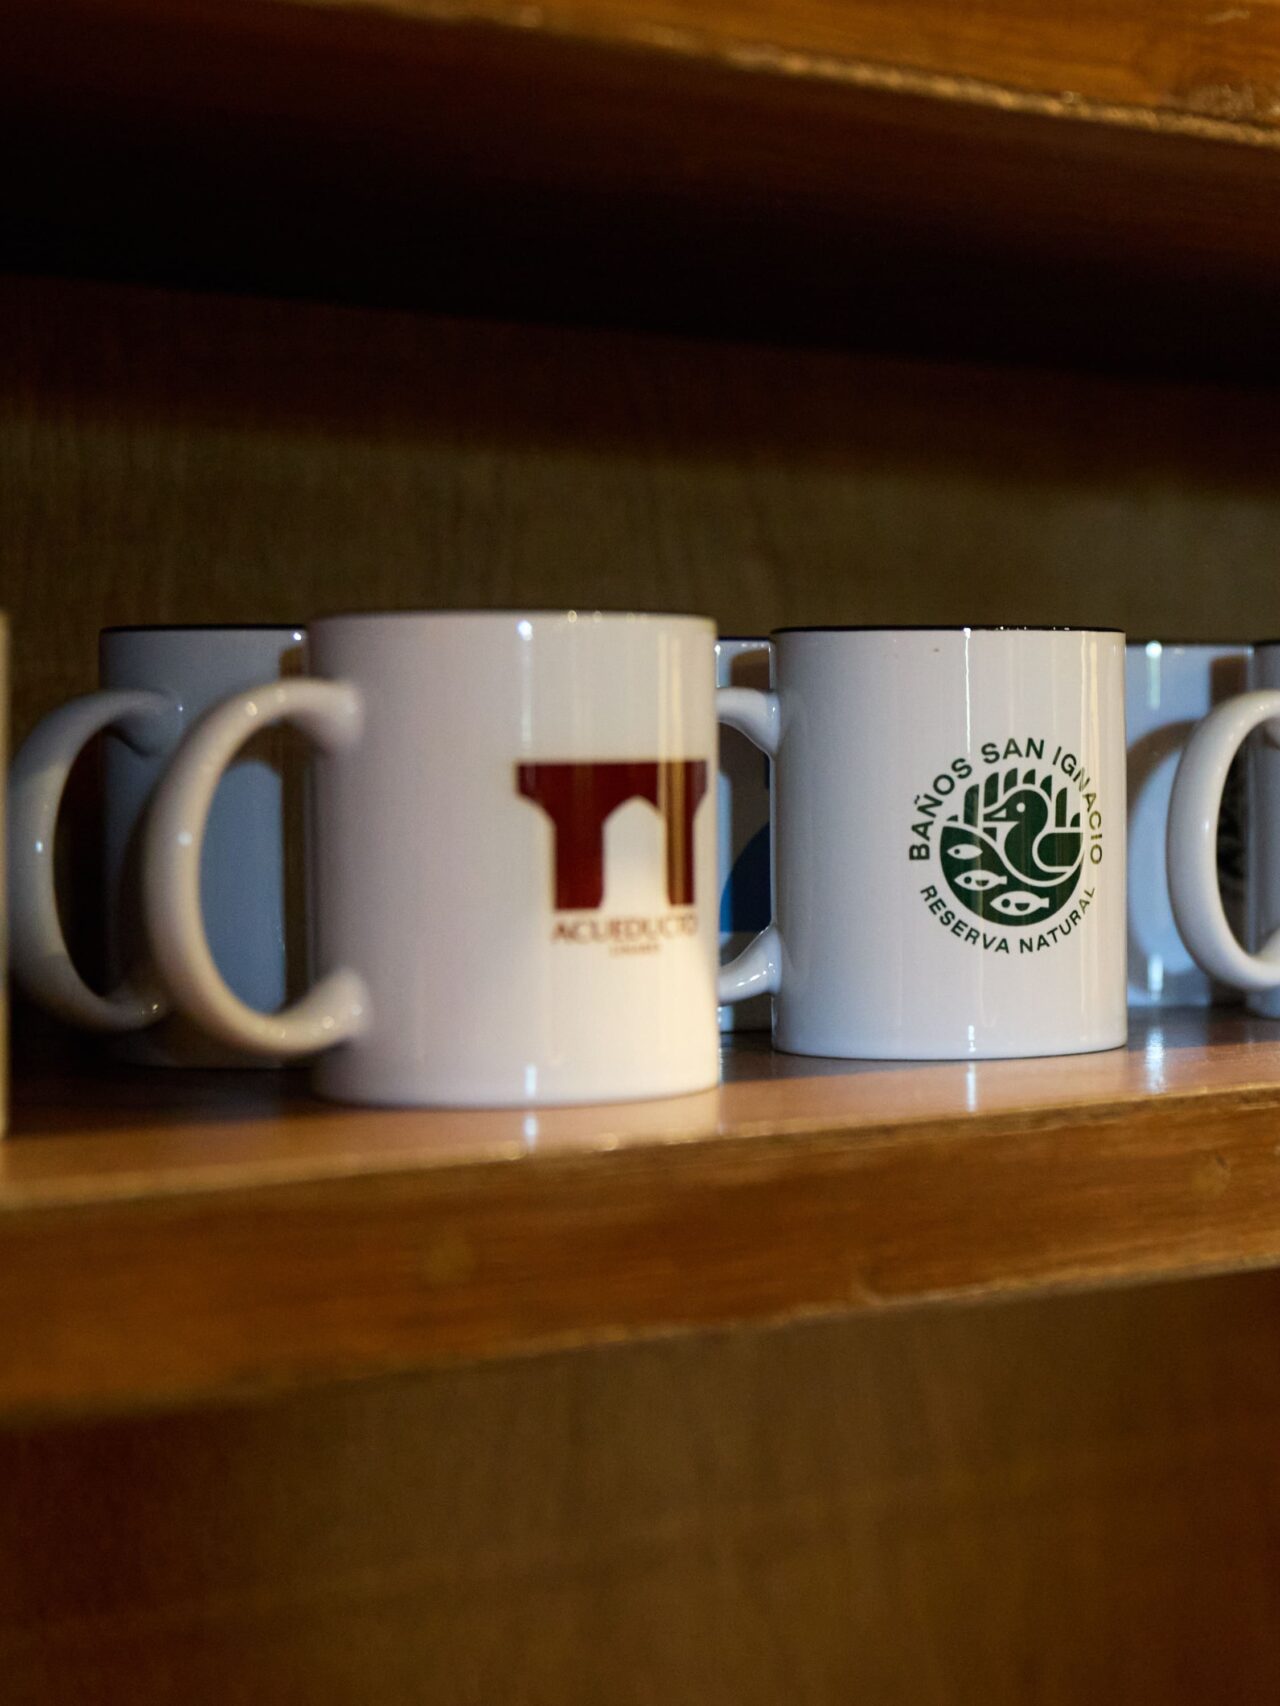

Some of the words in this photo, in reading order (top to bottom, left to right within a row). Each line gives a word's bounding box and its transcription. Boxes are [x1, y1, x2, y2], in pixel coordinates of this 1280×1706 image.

[909, 758, 973, 861] BAÑOS
[981, 737, 1044, 763] SAN
[1052, 746, 1103, 865] IGNACIO
[920, 885, 1010, 954] RESERVA
[1019, 886, 1096, 954] NATURAL
